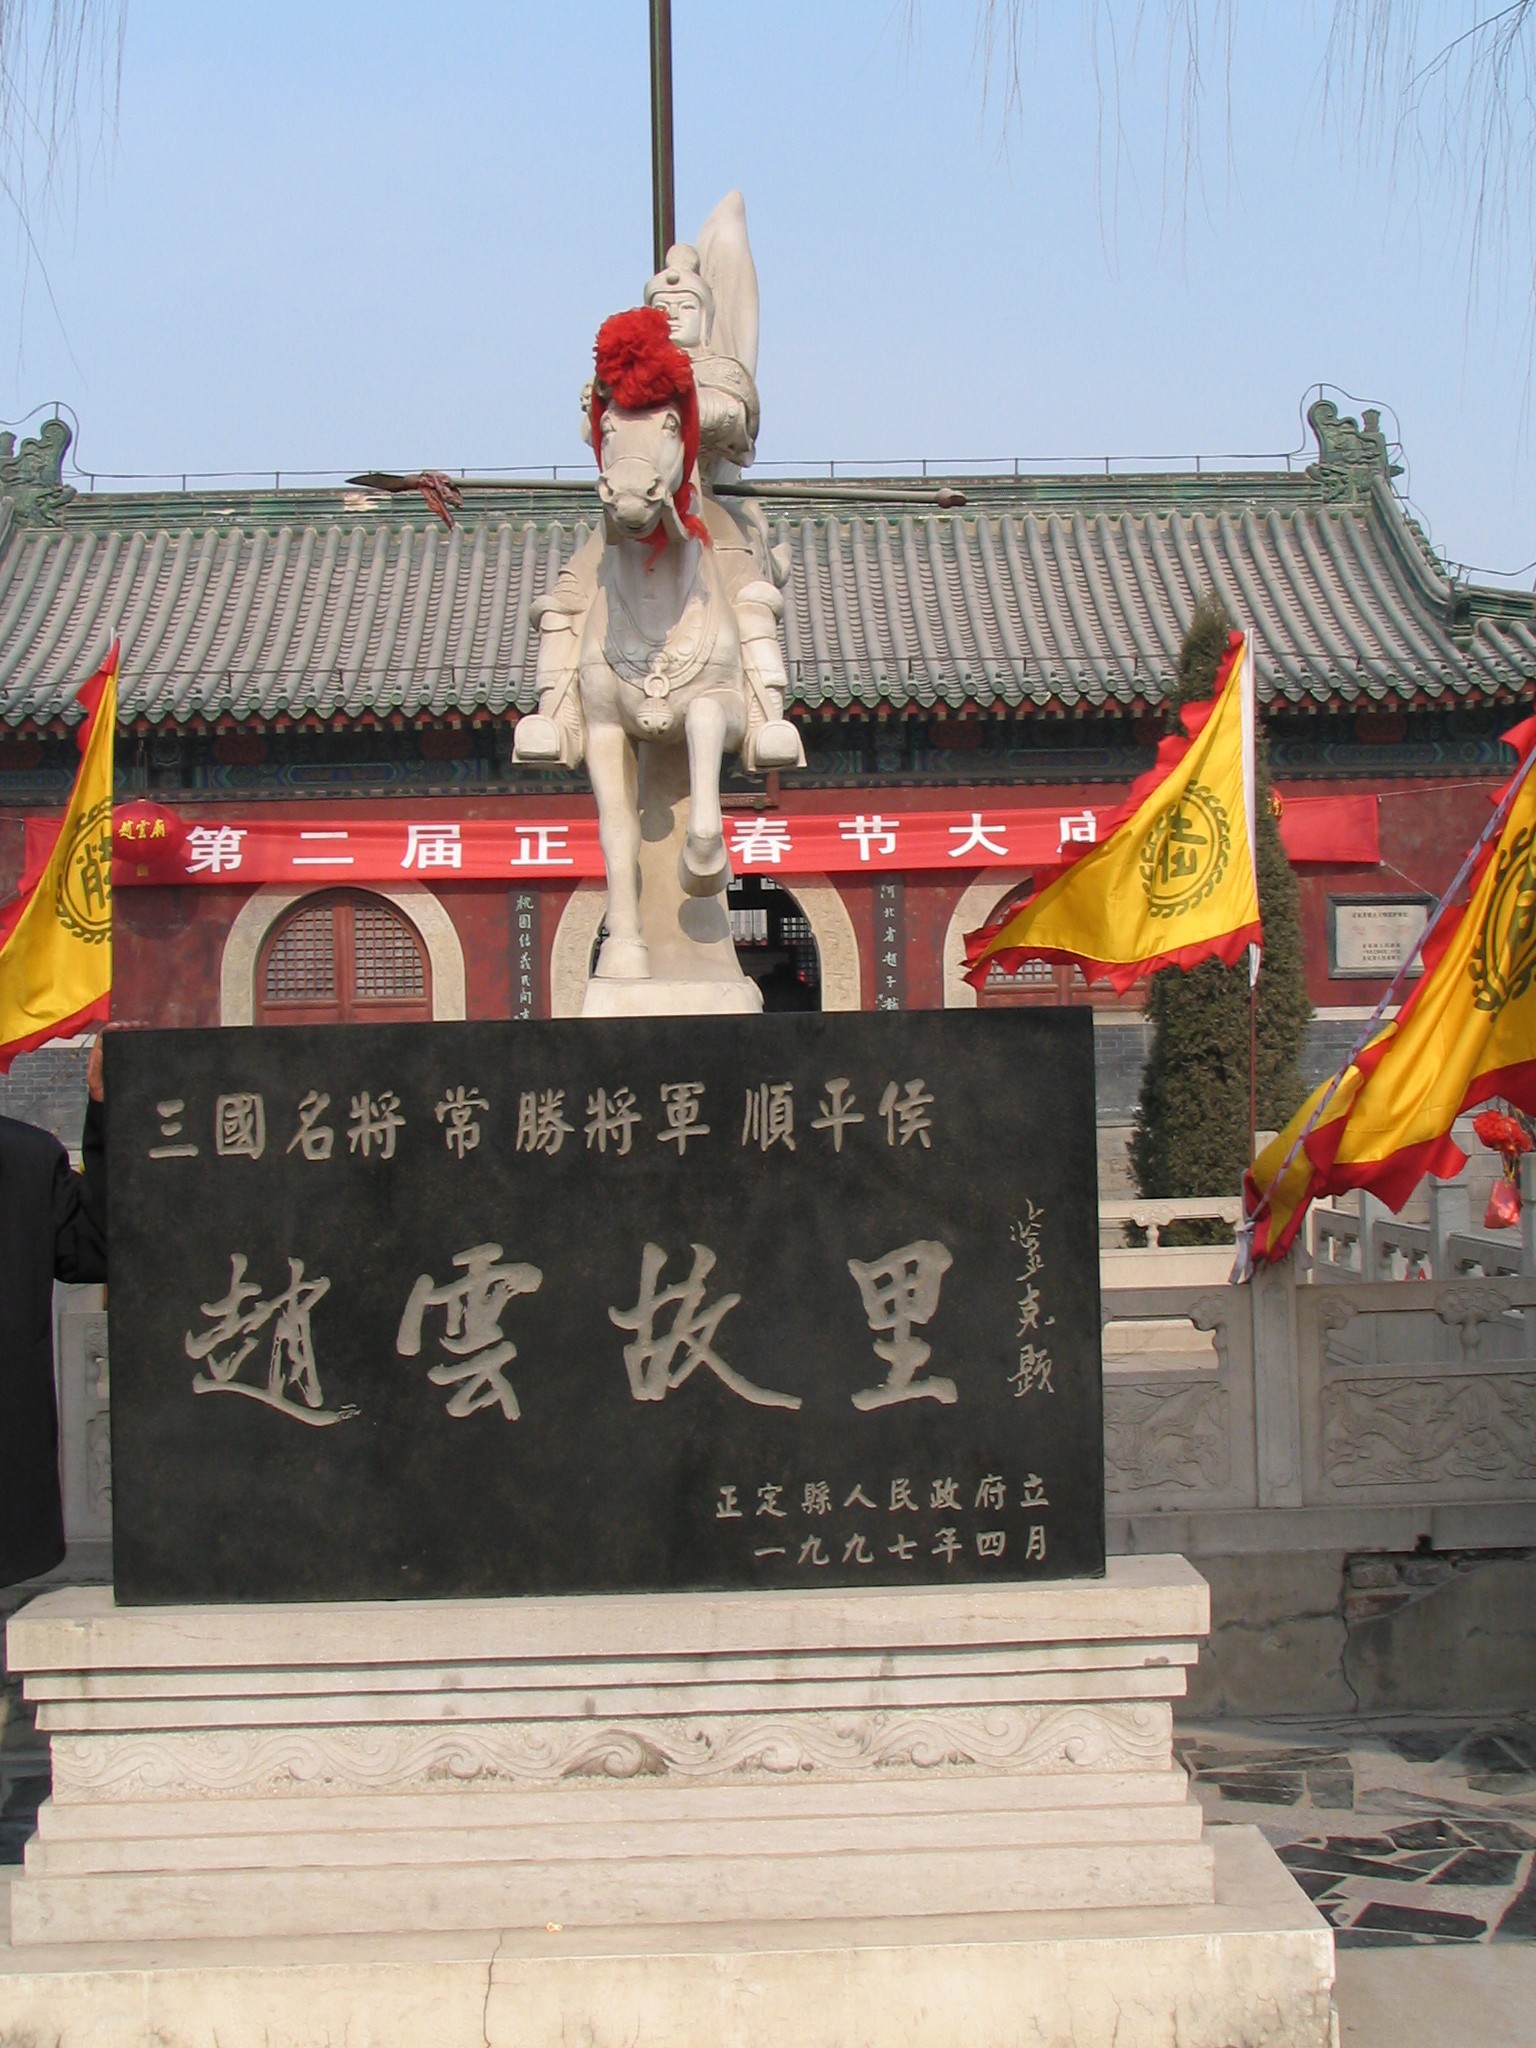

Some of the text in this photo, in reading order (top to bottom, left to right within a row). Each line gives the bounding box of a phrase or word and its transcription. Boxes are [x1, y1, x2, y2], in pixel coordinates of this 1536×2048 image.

[184, 1240, 960, 1428] 趙雲故里
[715, 1473, 1050, 1519] 正定縣人民政府立
[754, 1524, 1047, 1565] 一九九七年四月
